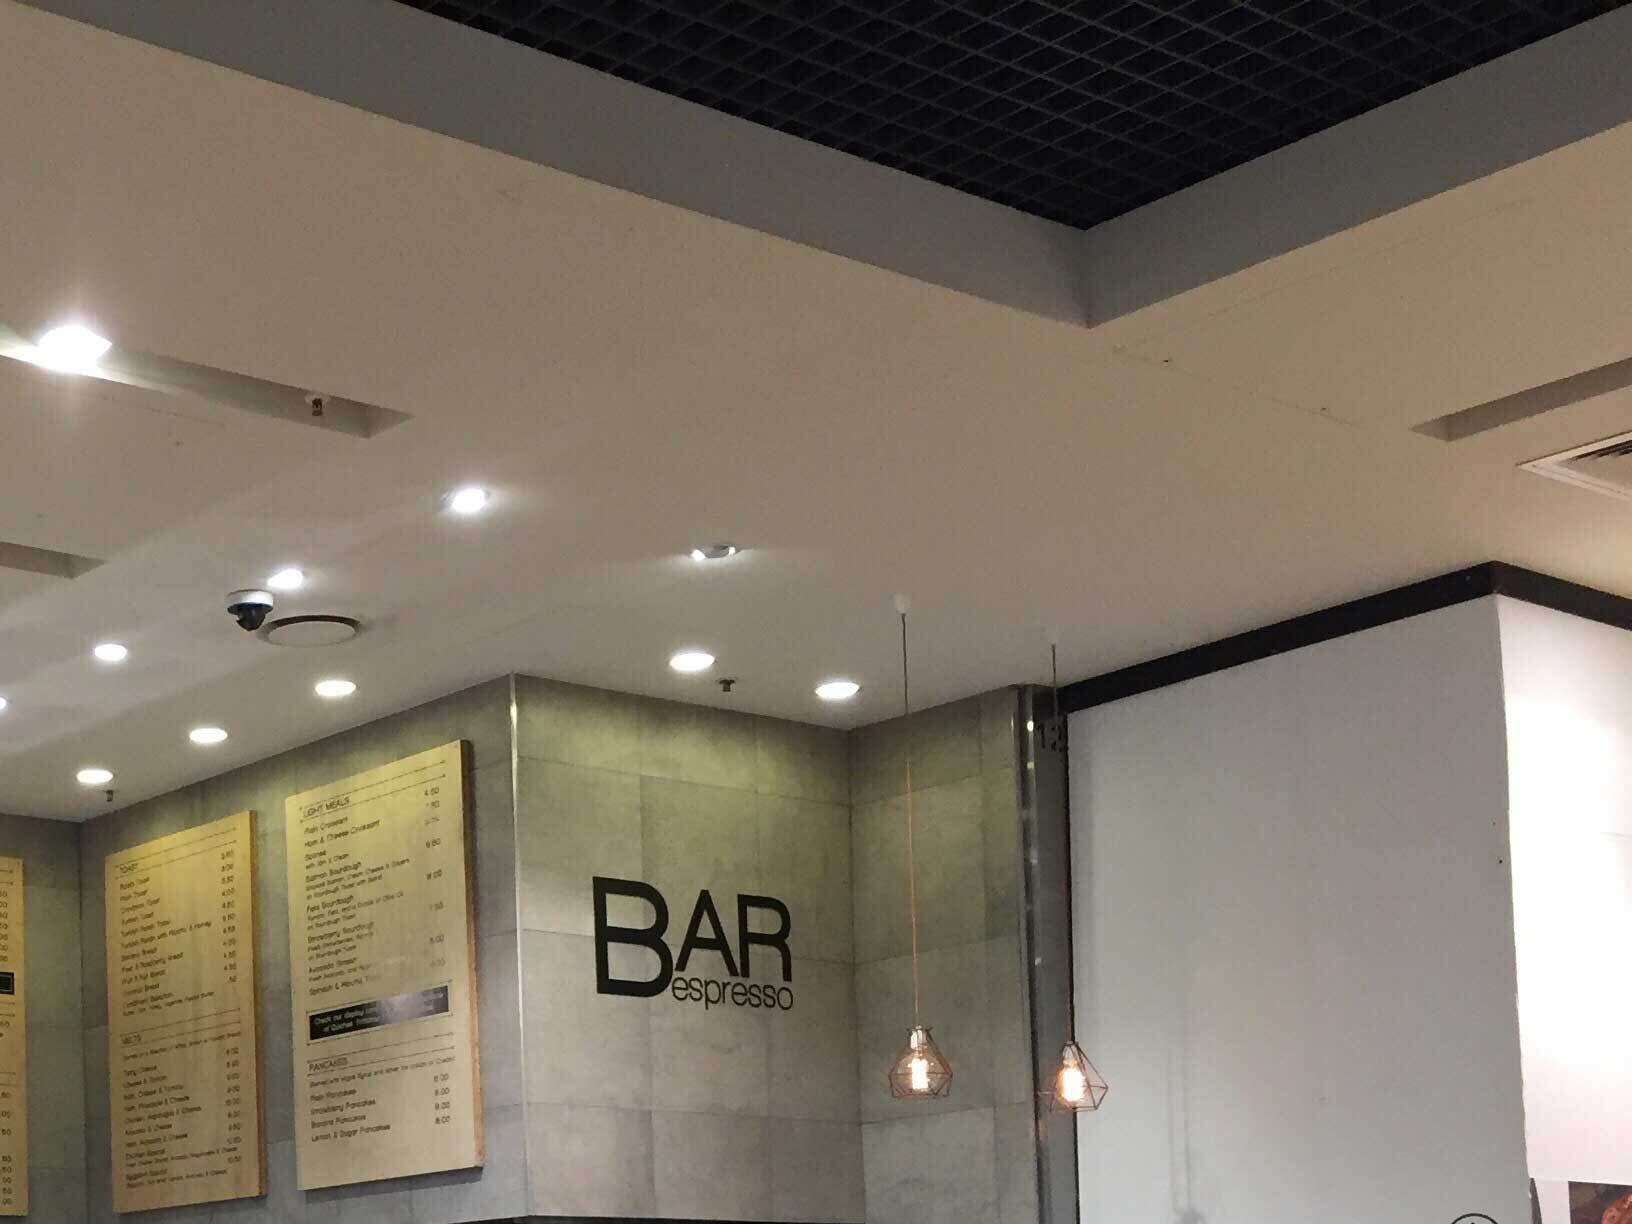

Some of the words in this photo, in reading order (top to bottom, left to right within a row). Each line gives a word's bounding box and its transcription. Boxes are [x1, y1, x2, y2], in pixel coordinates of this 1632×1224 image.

[326, 796, 350, 811] MEALS
[592, 876, 792, 998] BAR
[671, 976, 794, 1011] espresso
